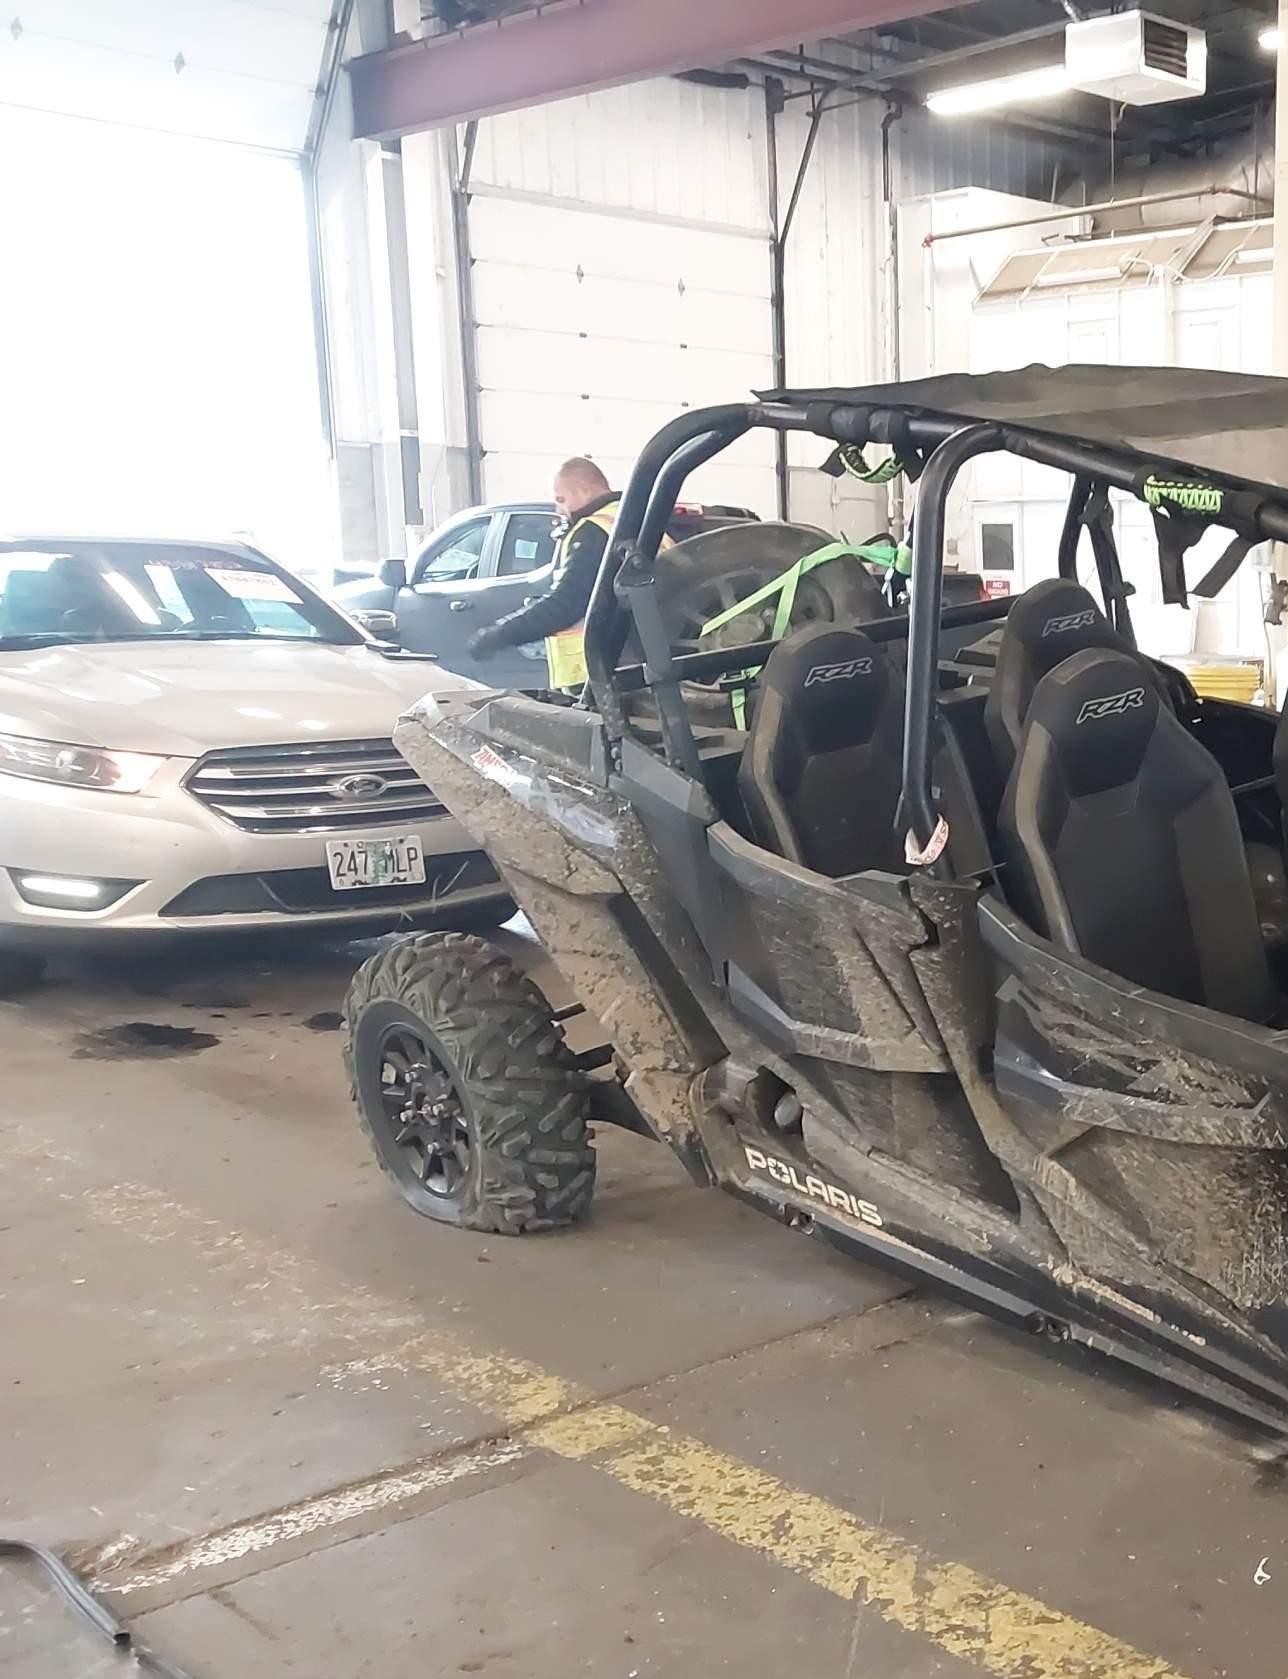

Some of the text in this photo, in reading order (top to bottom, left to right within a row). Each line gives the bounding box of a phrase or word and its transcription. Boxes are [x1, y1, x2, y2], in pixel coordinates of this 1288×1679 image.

[1041, 609, 1095, 637] RZR
[804, 657, 872, 687] RZR
[1076, 687, 1145, 724] RZR
[333, 847, 418, 877] 247 MLP
[745, 1147, 883, 1227] POLARIS
